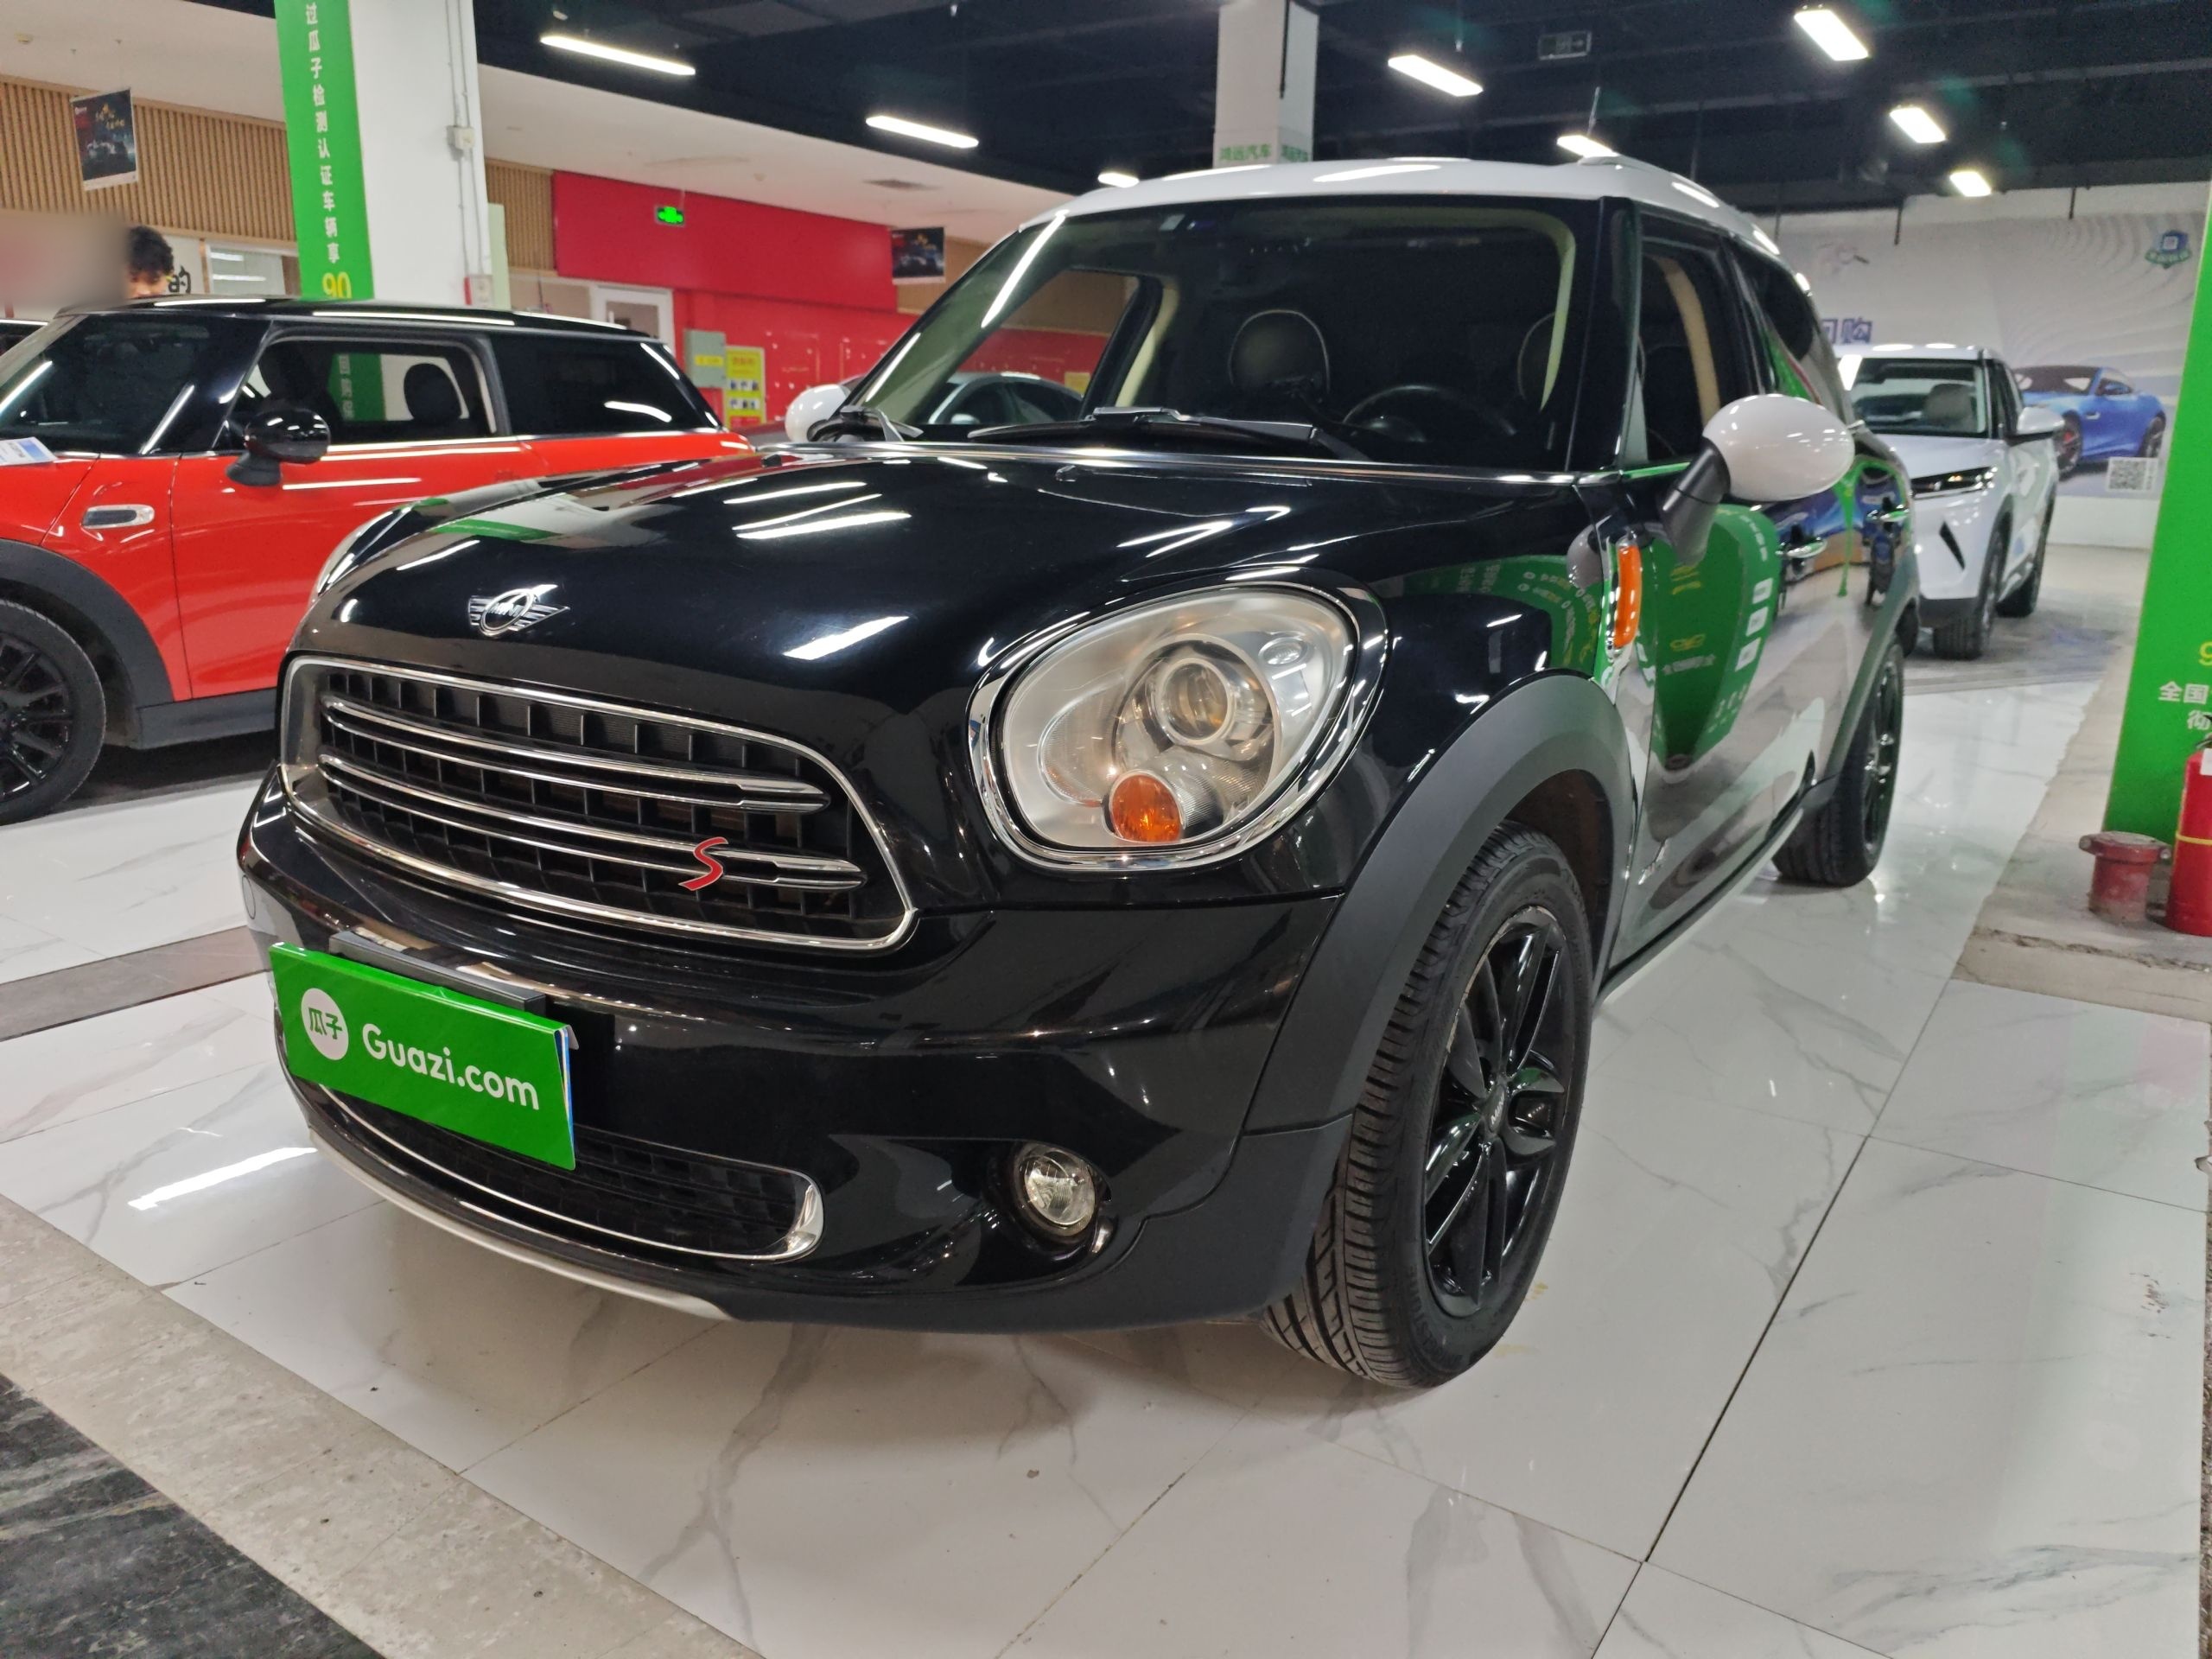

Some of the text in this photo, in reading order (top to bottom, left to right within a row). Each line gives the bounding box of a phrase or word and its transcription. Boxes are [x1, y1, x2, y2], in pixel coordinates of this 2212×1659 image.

[2158, 681, 2209, 704] 全国
[678, 836, 728, 891] S
[308, 1007, 343, 1039] 瓜子
[363, 1023, 540, 1110] Guazi.com
